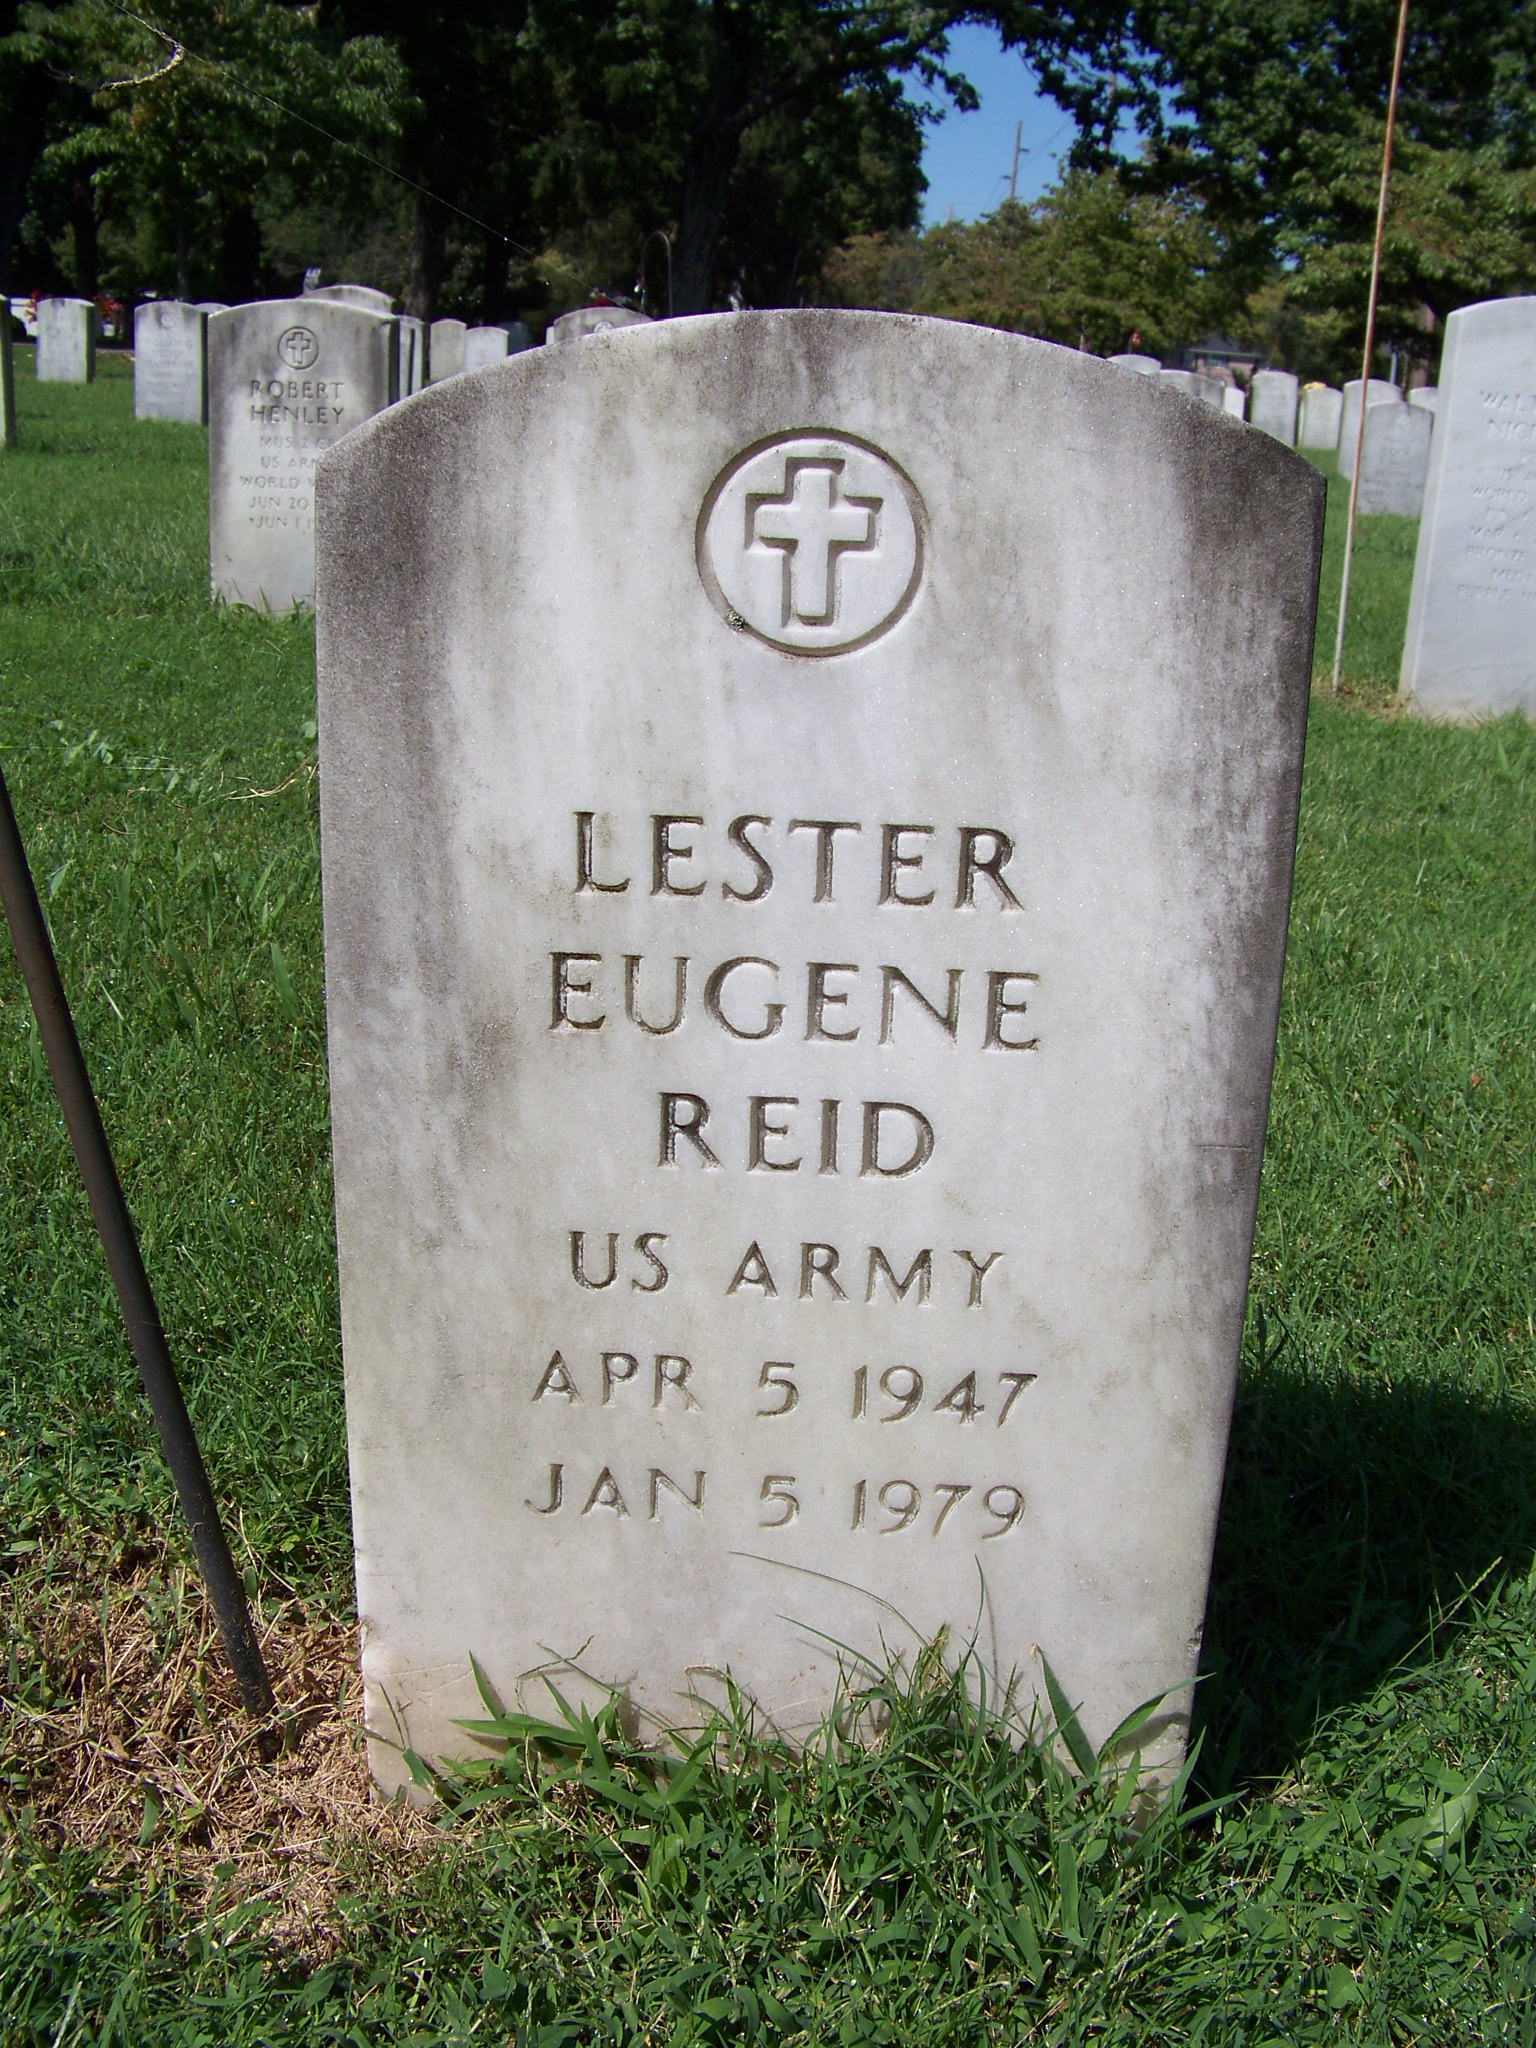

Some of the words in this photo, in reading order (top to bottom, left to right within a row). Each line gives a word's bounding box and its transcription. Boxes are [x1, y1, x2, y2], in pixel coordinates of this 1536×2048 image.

[250, 380, 345, 400] ROBERT
[250, 405, 345, 425] HENLEY
[260, 436, 292, 450] MUS
[261, 456, 279, 469] US
[240, 475, 300, 490] WORLD
[249, 496, 281, 510] JUN
[288, 497, 309, 511] 20
[1470, 485, 1527, 504] WORLD
[255, 516, 287, 529] JUN
[1466, 545, 1528, 563] BRONZE
[573, 811, 1025, 912] LESTER
[549, 952, 1041, 1052] EUGENE
[657, 1091, 936, 1179] REID
[569, 1231, 668, 1293] US
[726, 1241, 1005, 1308] ARMY
[532, 1350, 702, 1412] APR
[756, 1361, 800, 1418] 5
[852, 1365, 1038, 1429] 1947
[524, 1463, 706, 1520] JAN
[758, 1475, 800, 1529] 5
[851, 1478, 1025, 1541] 1979
